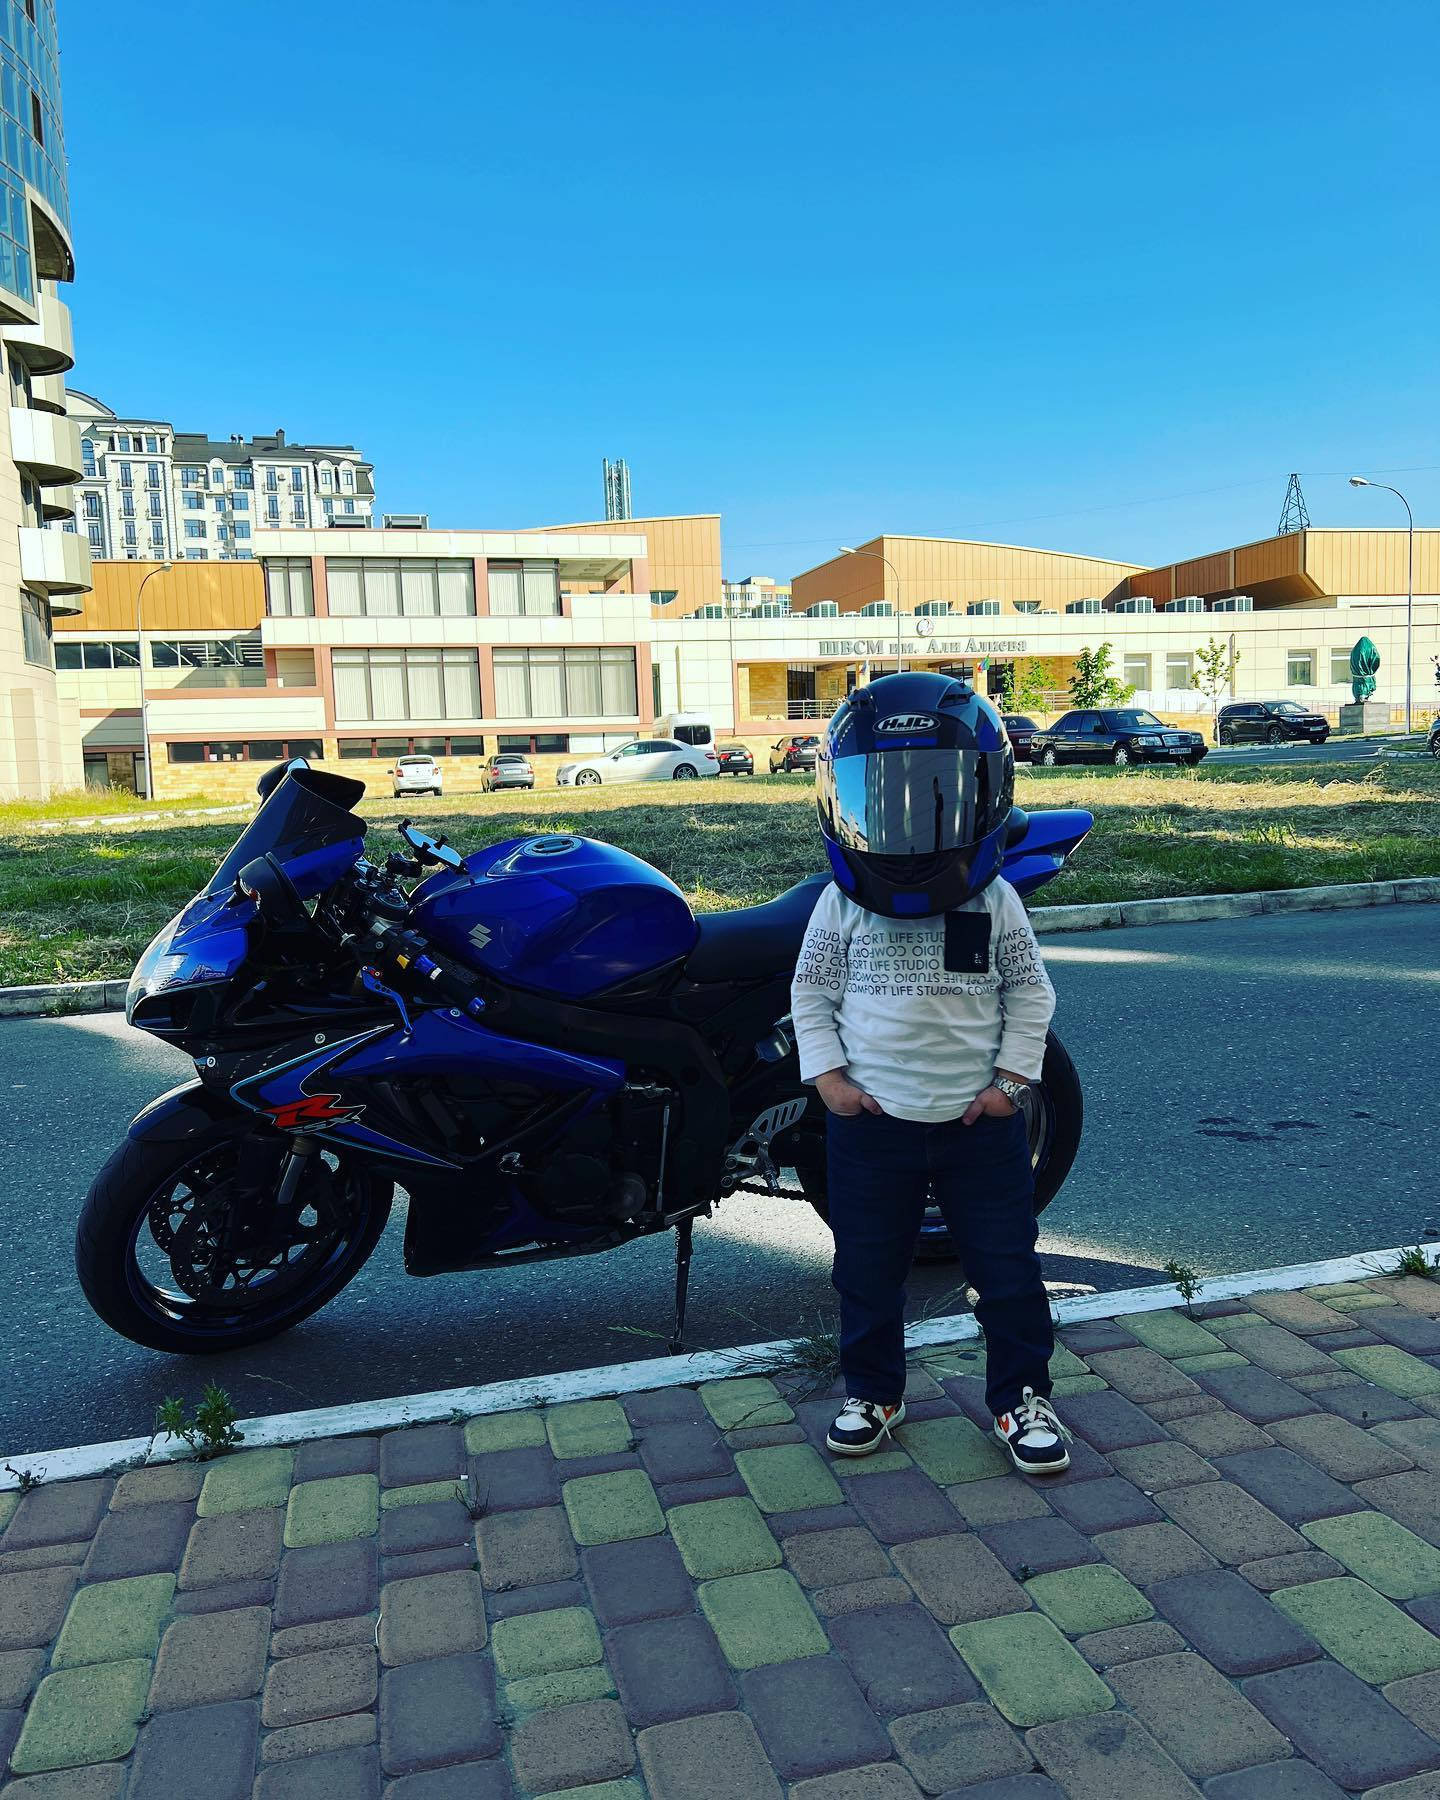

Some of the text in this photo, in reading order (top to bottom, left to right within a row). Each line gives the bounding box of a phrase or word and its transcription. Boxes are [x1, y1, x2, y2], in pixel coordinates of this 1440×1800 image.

[818, 640, 884, 656] ШВСМ
[926, 638, 961, 654] Али
[965, 637, 1027, 653] Алиева
[881, 717, 931, 730] HJC
[889, 932, 914, 943] LIFE
[853, 945, 907, 958] COMFORT
[870, 960, 890, 971] LIFE
[893, 959, 940, 970] STUDIO
[825, 967, 846, 979] LIFE
[894, 972, 941, 983] STUDIO
[796, 973, 841, 990] STUDIO
[847, 983, 887, 996] COMFORT
[891, 986, 913, 996] LIFE
[917, 985, 963, 996] STUDIO
